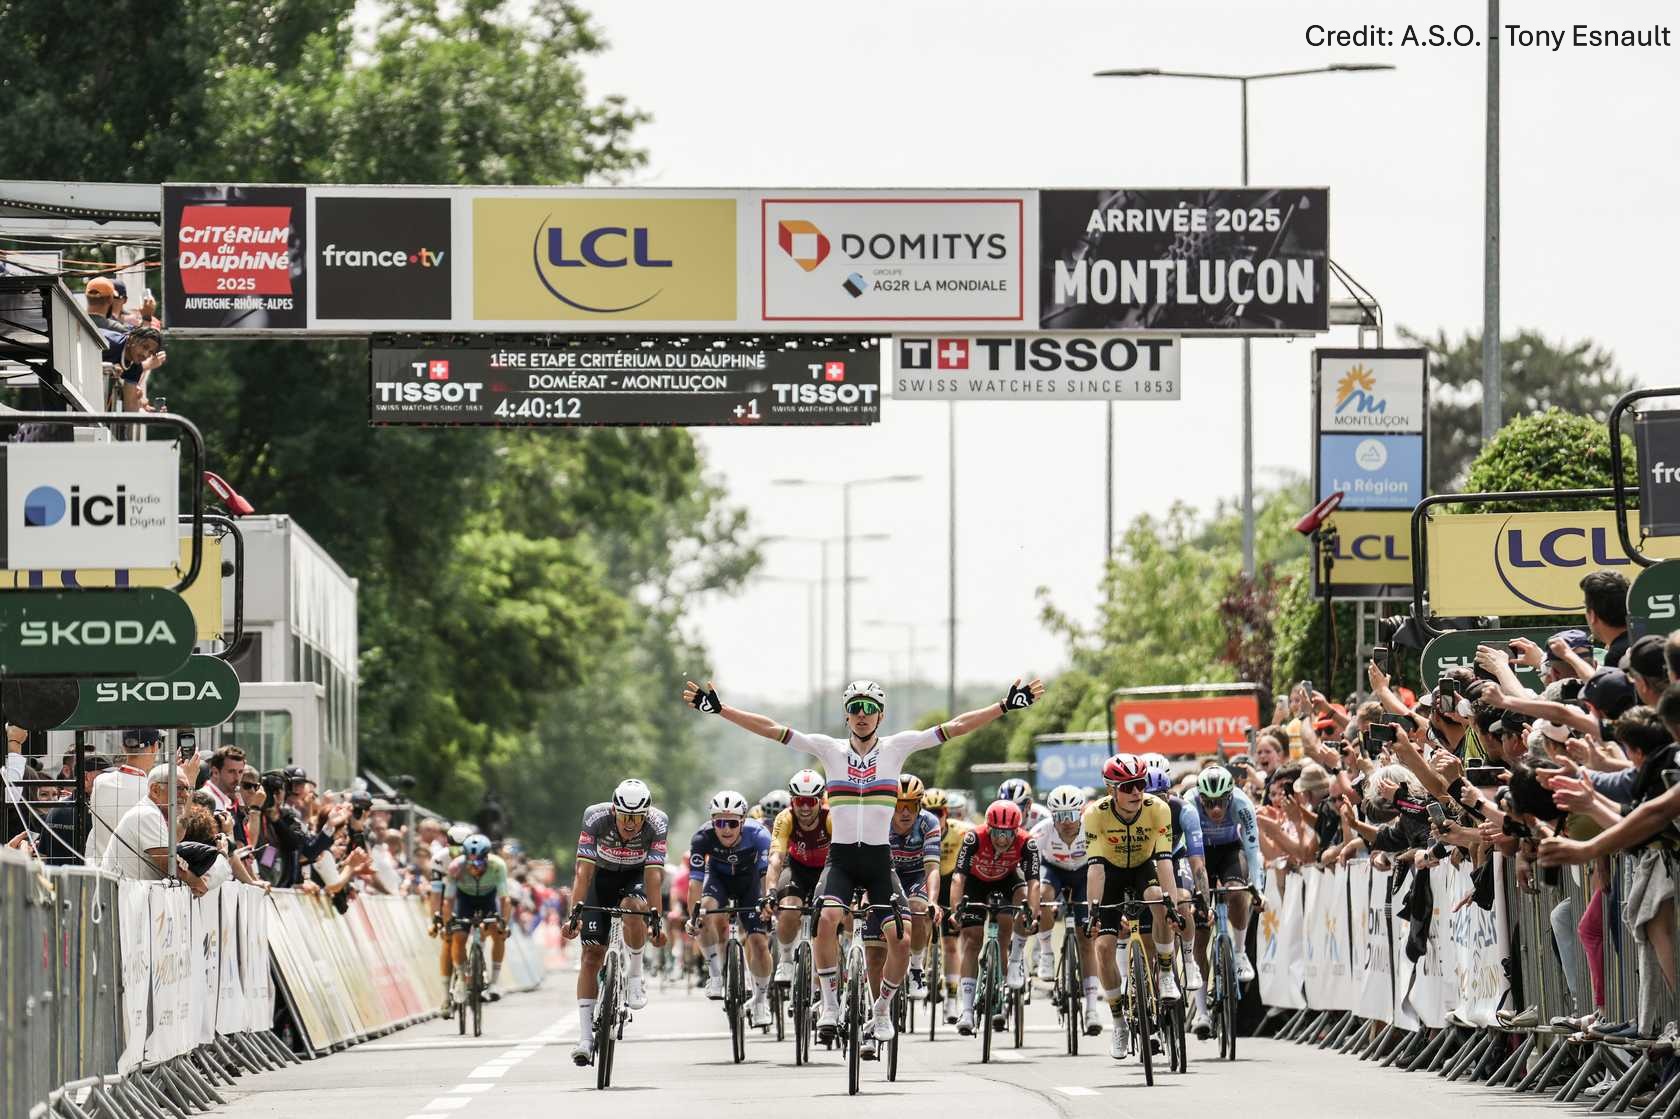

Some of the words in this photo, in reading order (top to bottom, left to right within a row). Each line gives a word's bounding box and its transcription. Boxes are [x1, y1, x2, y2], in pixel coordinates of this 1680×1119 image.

[1086, 201, 1207, 232] ARRIVÉE
[1215, 208, 1281, 232] 2025
[217, 244, 235, 254] du
[547, 226, 673, 268] LCL
[841, 233, 1007, 260] DOMITYS
[217, 278, 256, 291] 2025
[873, 280, 910, 291] AG2R
[914, 280, 932, 291] LA
[936, 279, 1007, 291] MONDIALE
[1054, 259, 1314, 316] MONTLUÇON
[530, 353, 576, 367] ETAPE
[580, 349, 661, 368] CRITÉRIUM
[665, 353, 687, 368] DU
[690, 350, 766, 368] DAUPHINÉ
[976, 337, 1173, 372] TISSOT
[529, 371, 608, 388] DOMÉRAT
[622, 375, 727, 391] MONTLUÇON
[899, 379, 958, 393] SWISS
[969, 379, 1056, 393] WATCHES
[1068, 380, 1122, 393] SINCE
[1134, 380, 1173, 393] 1853
[376, 382, 483, 402] TISSOT
[772, 383, 878, 404] TISSOT
[494, 398, 581, 418] 4:40:12
[733, 398, 761, 418] +1
[1334, 415, 1409, 428] MONTLUÇON
[1355, 478, 1408, 496] Région
[71, 485, 126, 527] ici
[130, 495, 160, 504] Radio
[131, 507, 143, 515] TV
[129, 517, 166, 529] Digital
[1332, 535, 1409, 560] LCL
[1507, 527, 1631, 568] LCL
[1159, 716, 1249, 737] DOMITYS
[848, 756, 877, 769] UAE
